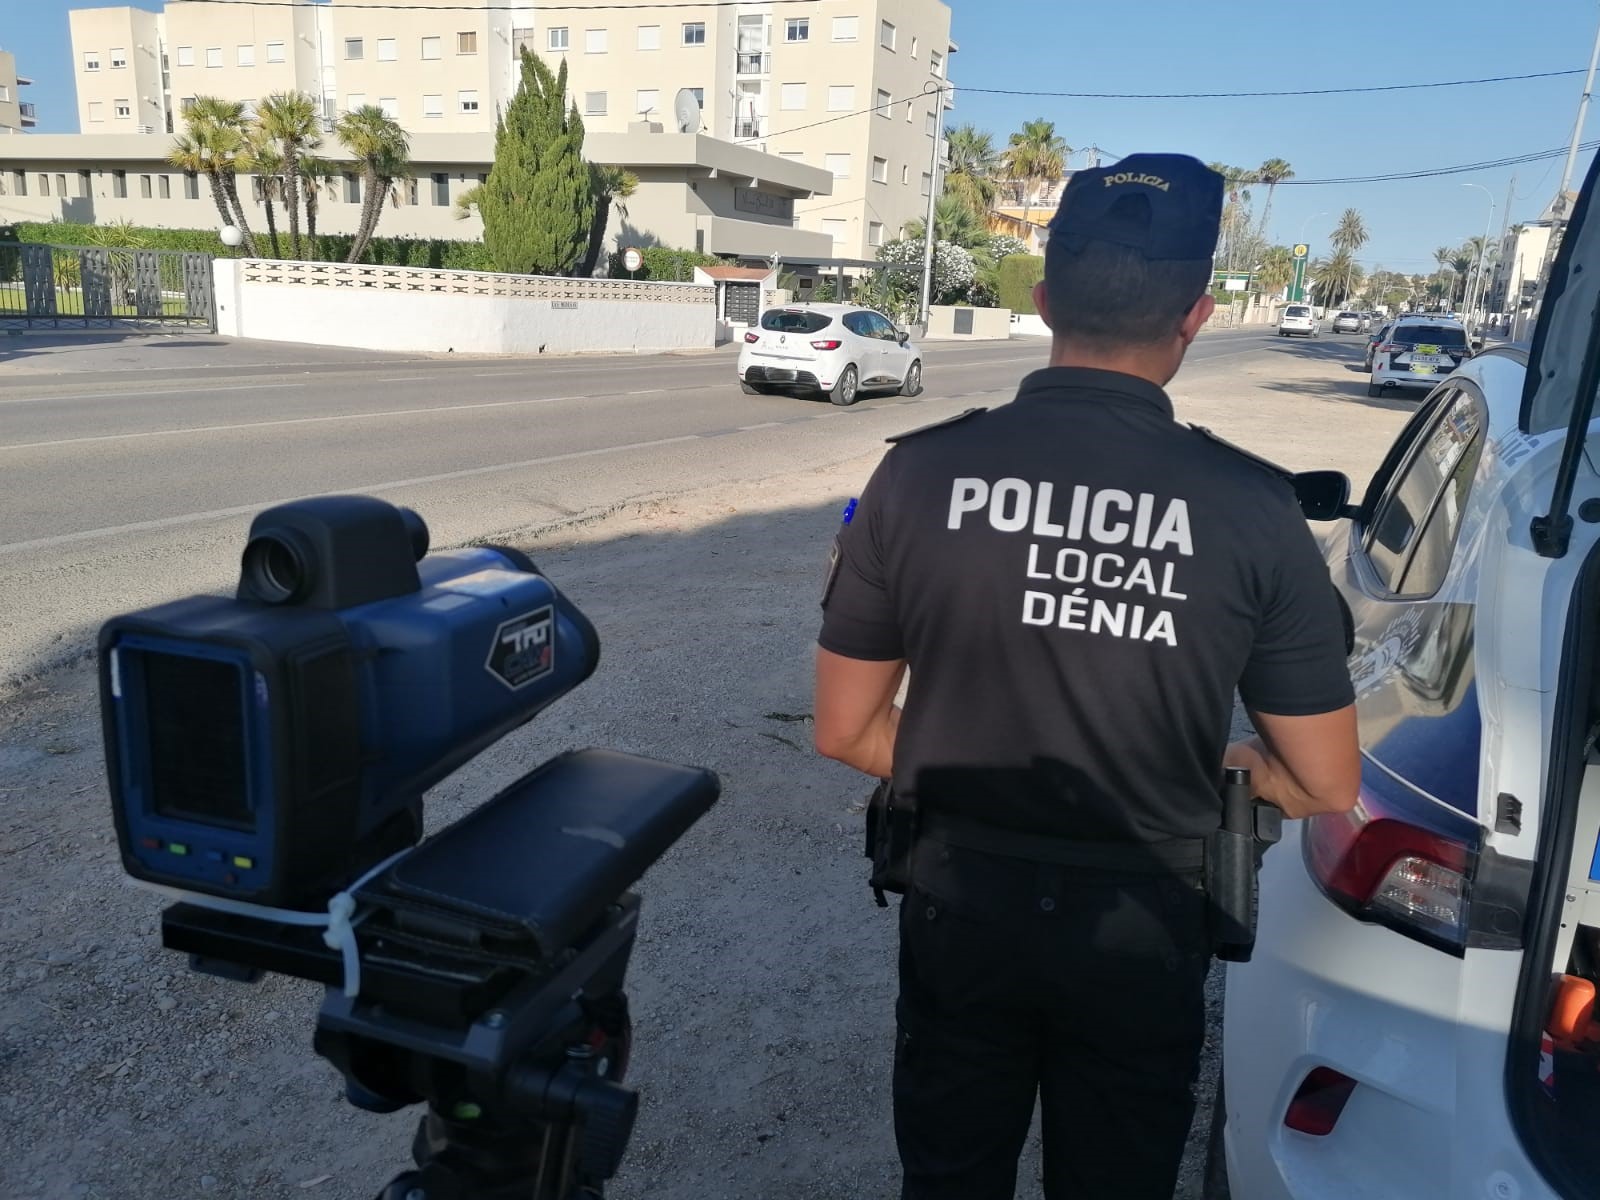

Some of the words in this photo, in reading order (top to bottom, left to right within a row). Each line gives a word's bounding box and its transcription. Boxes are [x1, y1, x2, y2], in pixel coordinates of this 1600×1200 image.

[1103, 172, 1170, 192] POLICIA
[947, 477, 1194, 556] POLICIA
[1026, 543, 1188, 601] LOCAL
[1021, 587, 1178, 647] DÉNIA
